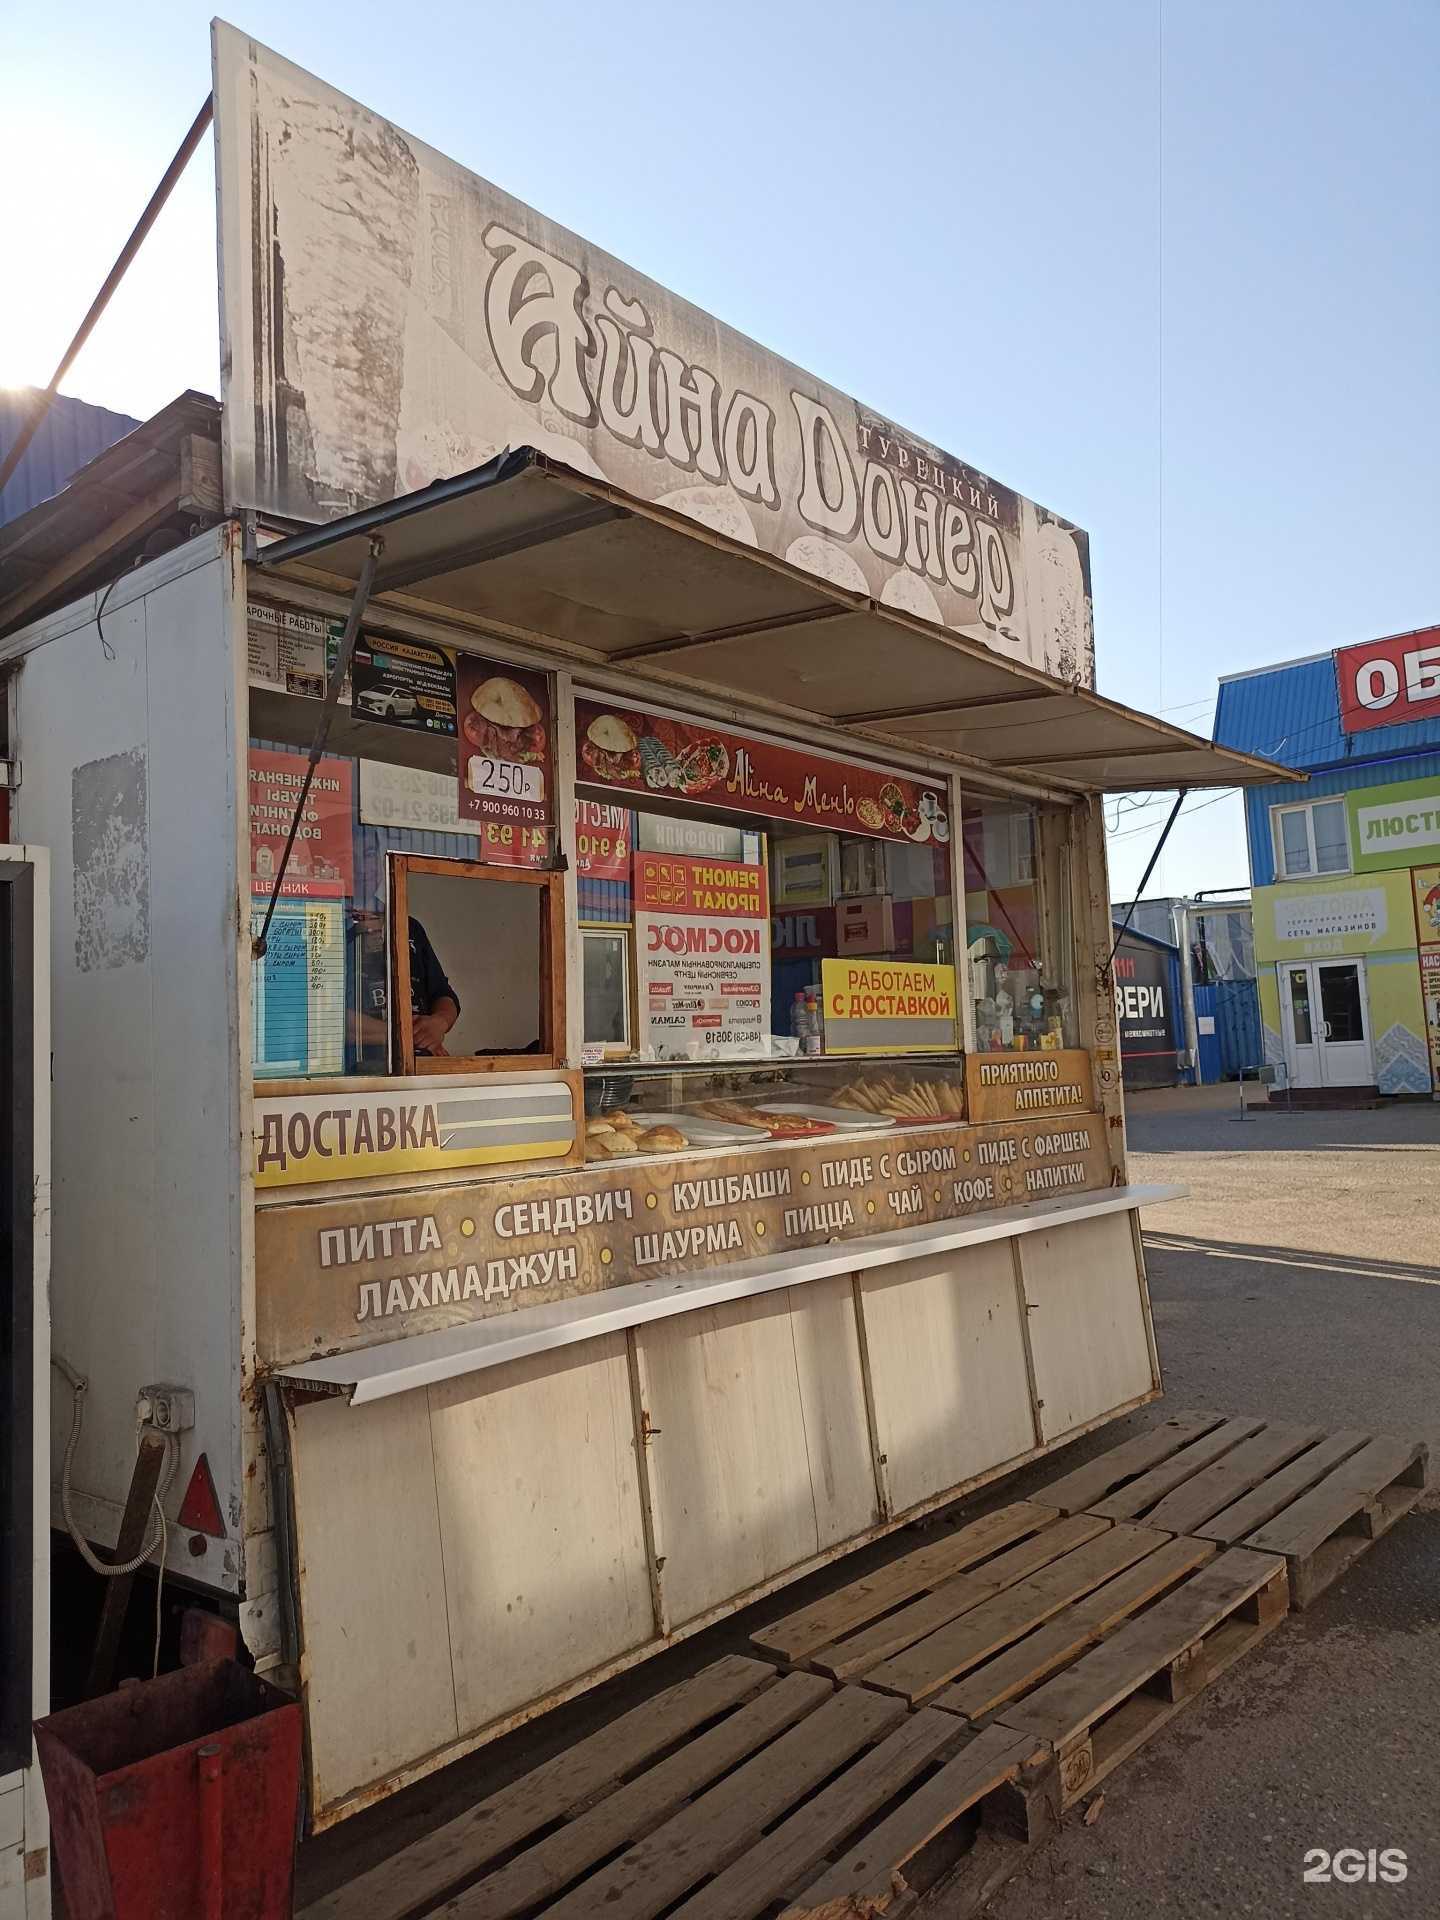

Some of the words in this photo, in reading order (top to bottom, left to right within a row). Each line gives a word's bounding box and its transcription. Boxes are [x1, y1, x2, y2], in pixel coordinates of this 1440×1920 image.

[481, 222, 780, 511] Айна
[858, 425, 1000, 519] ТУРЕЦКИЙ
[289, 617, 322, 633] РАБОТЫ
[727, 749, 788, 803] Айна
[794, 775, 854, 815] Меню
[468, 799, 480, 811] +7
[482, 801, 501, 814] 900
[502, 804, 520, 817] 960
[522, 807, 533, 819] 10
[532, 809, 545, 821] 33
[1287, 929, 1311, 938] СЕТЬ
[1317, 922, 1377, 934] МАГАЗИНОВ
[848, 969, 936, 992] РАБОТАЕМ
[832, 995, 844, 1014] С
[849, 991, 950, 1018] ДОСТАВКОЙ
[980, 1060, 1059, 1086] ПРИЯТНОГО
[1015, 1085, 1083, 1110] АППЕТИТА!
[257, 1103, 440, 1172] ДОСТАВКА
[319, 1215, 442, 1267] ПИТТА
[493, 1188, 634, 1238] СЕНДВИЧ
[672, 1168, 791, 1212] КУШБАШИ
[821, 1155, 873, 1188] ПИДЕ
[879, 1154, 890, 1178] С
[896, 1147, 956, 1175] СЫРОМ
[978, 1138, 1017, 1165] ПИДЕ
[1021, 1137, 1031, 1158] С
[1034, 1130, 1090, 1158] ФАРШЕМ
[356, 1248, 578, 1321] ЛАХМАДЖУН
[633, 1220, 743, 1266] ШАУРМА
[784, 1200, 855, 1237] ПИЦЦА
[888, 1184, 923, 1216] ЧАЙ
[953, 1176, 994, 1204] КОФЕ
[1024, 1162, 1086, 1192] НАПИТКИ
